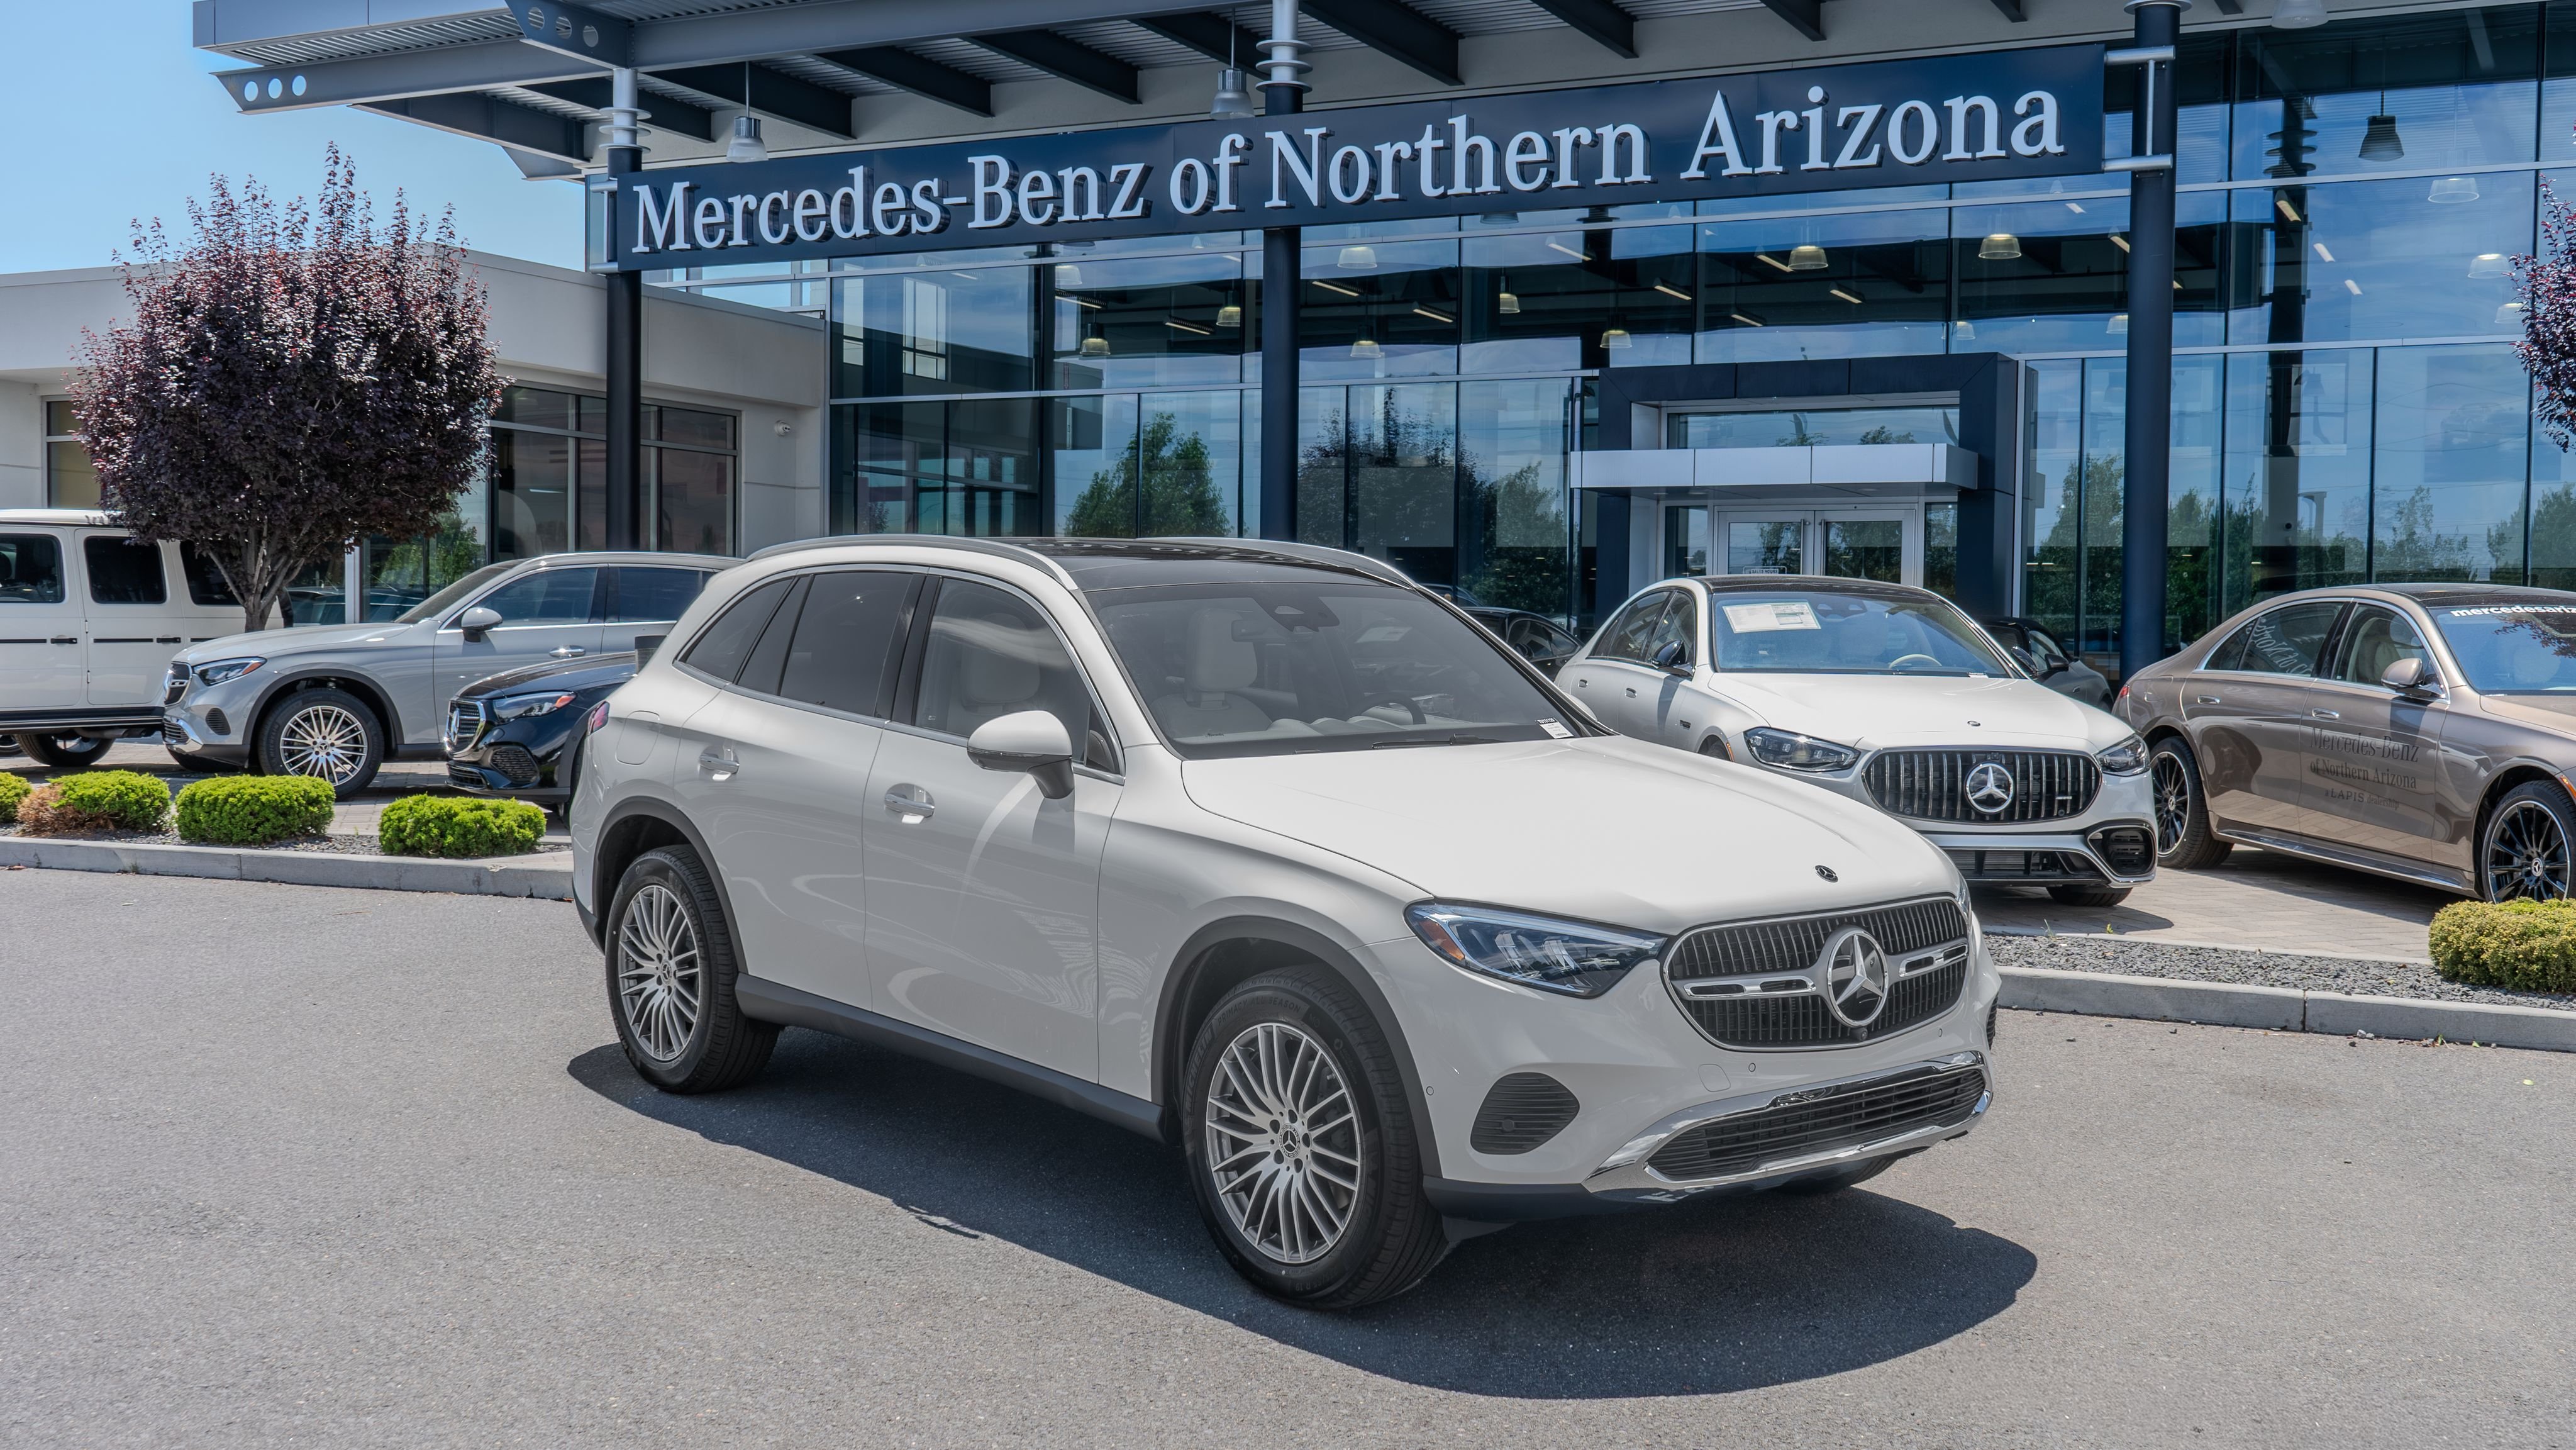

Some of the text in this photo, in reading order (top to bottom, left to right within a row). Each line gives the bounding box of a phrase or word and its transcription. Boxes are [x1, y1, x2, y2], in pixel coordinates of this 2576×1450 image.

[632, 86, 2067, 254] Mercedes-Benz of Northern Arizona
[2310, 727, 2419, 762] Mercedes-Benz
[2310, 758, 2417, 789] of Northern Arizona
[2331, 788, 2365, 803] LAPIS
[2367, 794, 2400, 810] dealership
[1218, 999, 1248, 1026] PRIMACY
[1252, 997, 1265, 1006] ALL
[1268, 996, 1301, 1013] SEASON
[1184, 1020, 1216, 1113] MICHELIN
